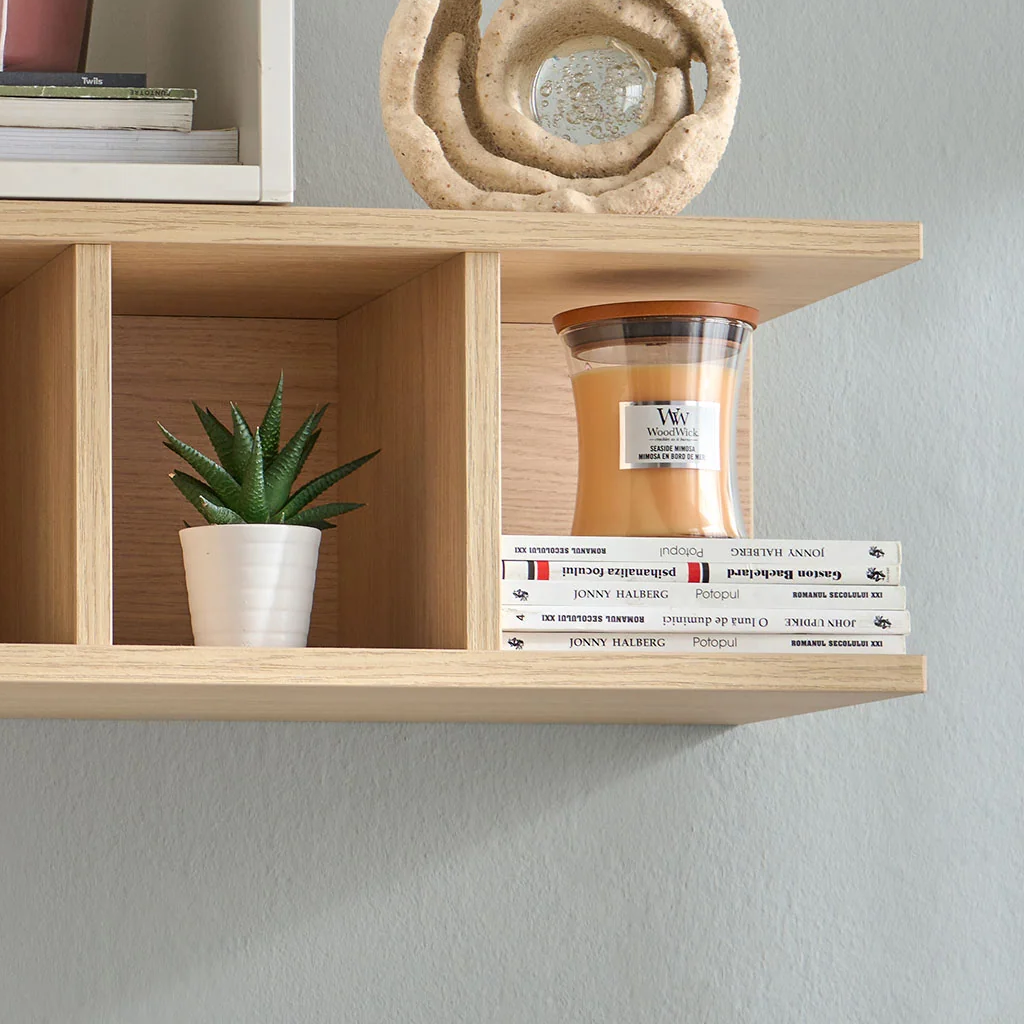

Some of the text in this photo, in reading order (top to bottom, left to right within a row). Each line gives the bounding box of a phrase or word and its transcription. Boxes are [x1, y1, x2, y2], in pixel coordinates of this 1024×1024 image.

[81, 76, 103, 85] Twils
[514, 546, 527, 554] XXI
[571, 547, 607, 555] ROMANUL
[659, 546, 704, 558] Potopul
[730, 547, 825, 558] JONNY HALBERG
[562, 566, 677, 579] psihanaliza focului
[727, 568, 842, 581] Gaston Bachelard
[573, 589, 669, 600] JONNY HALBERG
[695, 588, 740, 601] Potopul
[792, 591, 883, 599] ROMANUL SECOLULUI XXI
[541, 614, 645, 624] ROMANUL SECOLULUI XXI
[662, 616, 769, 628] O lună de duminici
[784, 617, 857, 628] JOHN UPDIKE
[569, 637, 666, 649] JONNY HALBERG
[692, 637, 738, 649] Potopul
